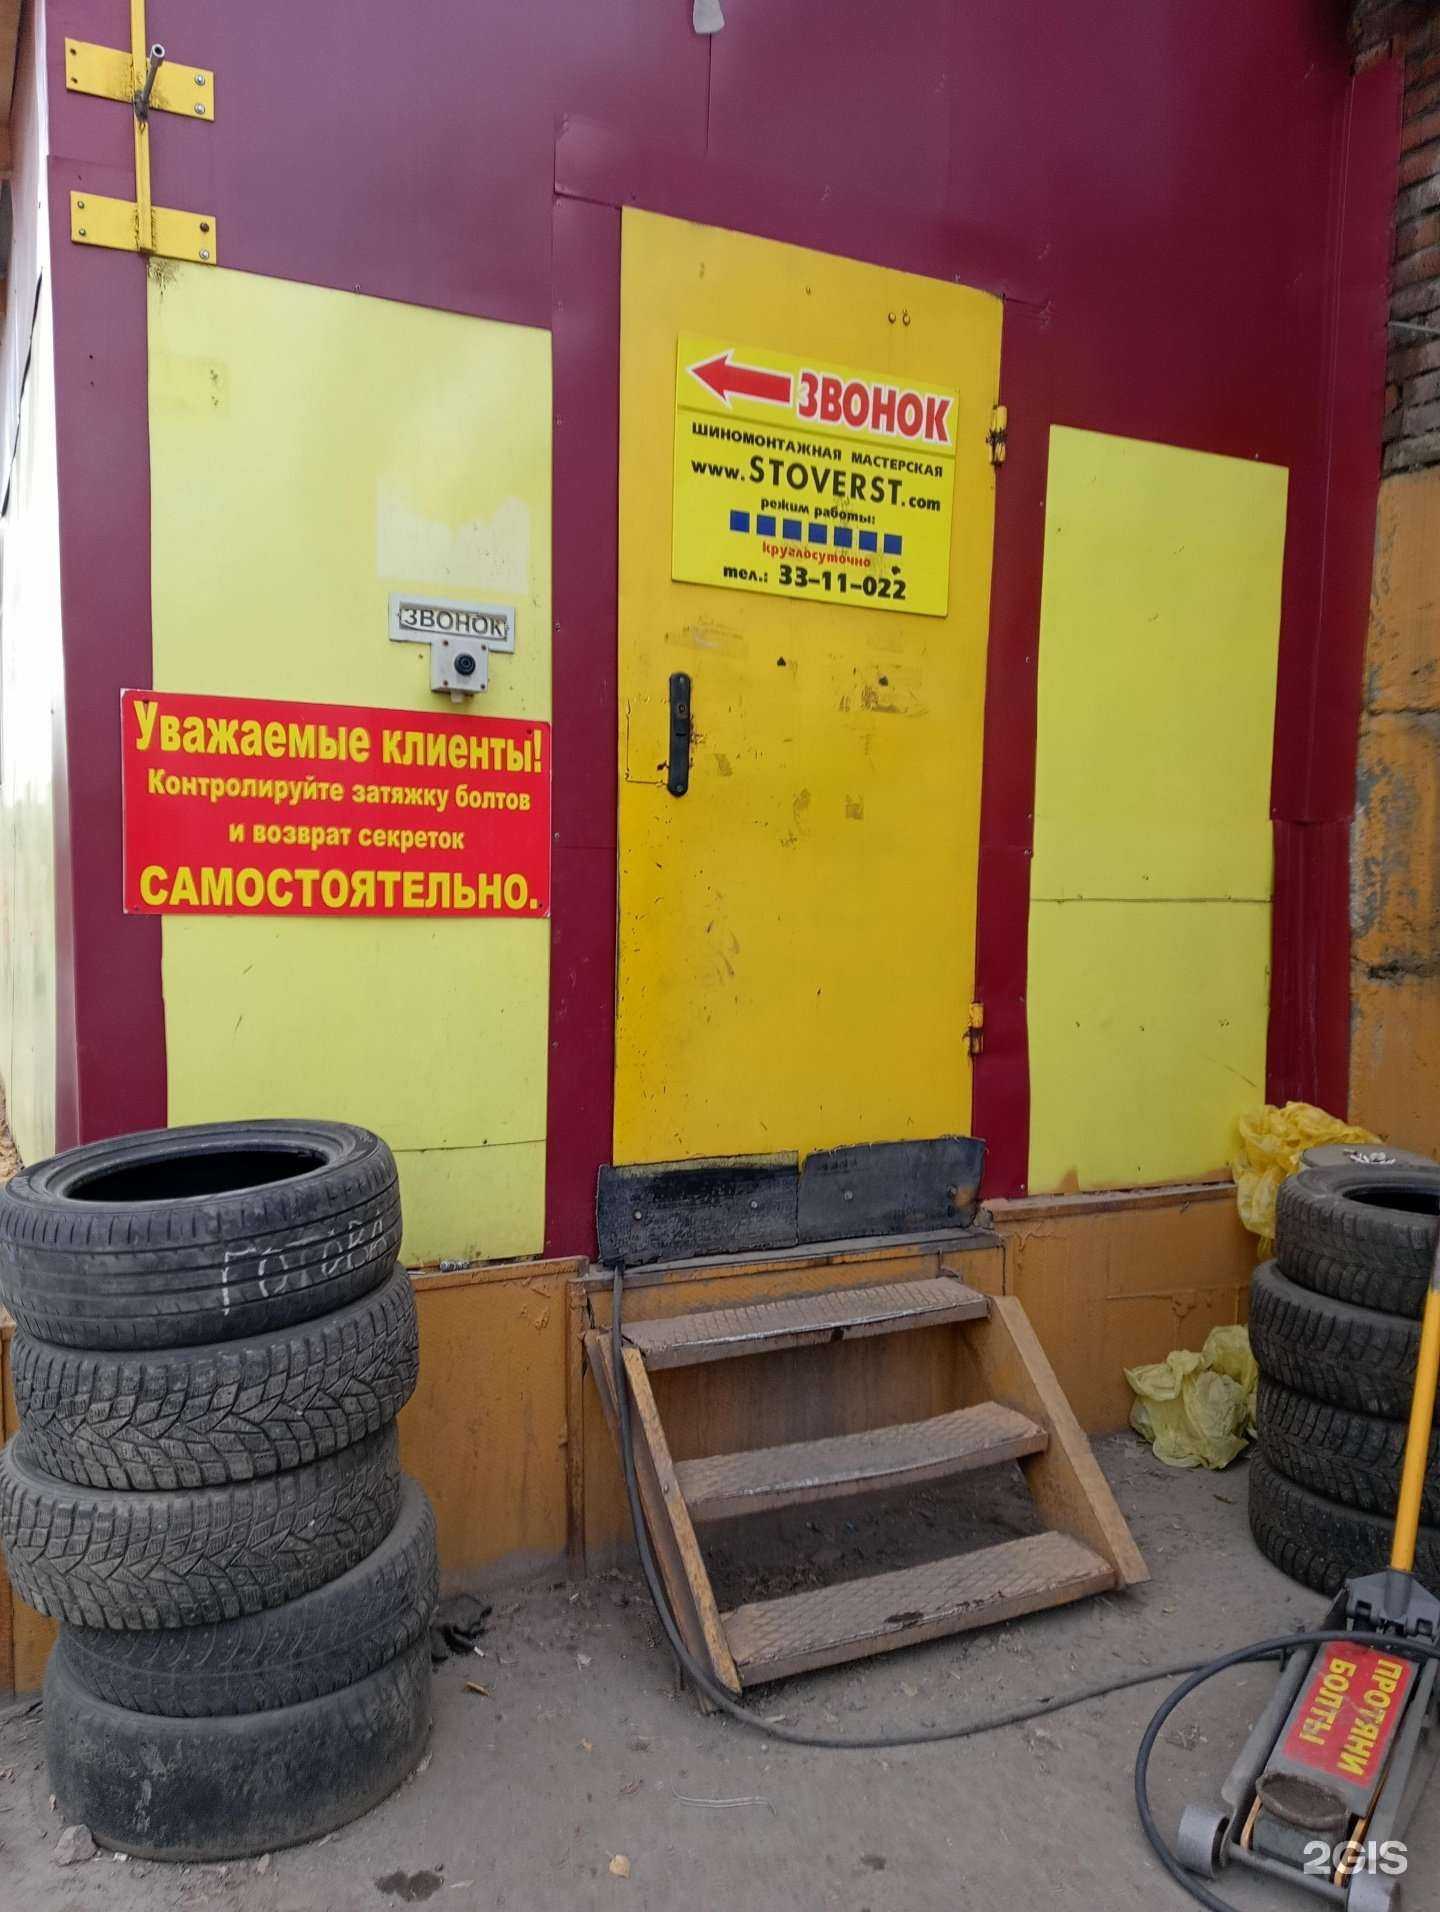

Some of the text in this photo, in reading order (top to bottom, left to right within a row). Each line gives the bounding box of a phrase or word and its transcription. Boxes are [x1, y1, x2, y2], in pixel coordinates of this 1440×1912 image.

[798, 371, 951, 442] ЗВОНОК
[691, 421, 944, 477] ШИНОМОНТАЖНАЯ МАСТЕРСКАЯ
[690, 454, 942, 511] www.STOVERST.com
[760, 497, 876, 525] режим работы:
[762, 541, 872, 567] круглосуточно
[723, 564, 906, 600] тел.: 33-11-022
[404, 608, 503, 637] ЗВОНОК
[133, 700, 543, 773] Уважаемые клиенты!
[147, 768, 531, 812] Контролируйте затяжку болтов
[228, 823, 465, 853] и возврат секреток
[139, 865, 539, 910] САМОСТОЯТЕЛЬНО.
[1299, 1657, 1357, 1746] БОЛТЫ
[1337, 1658, 1403, 1776] ПРОТЯНИ
